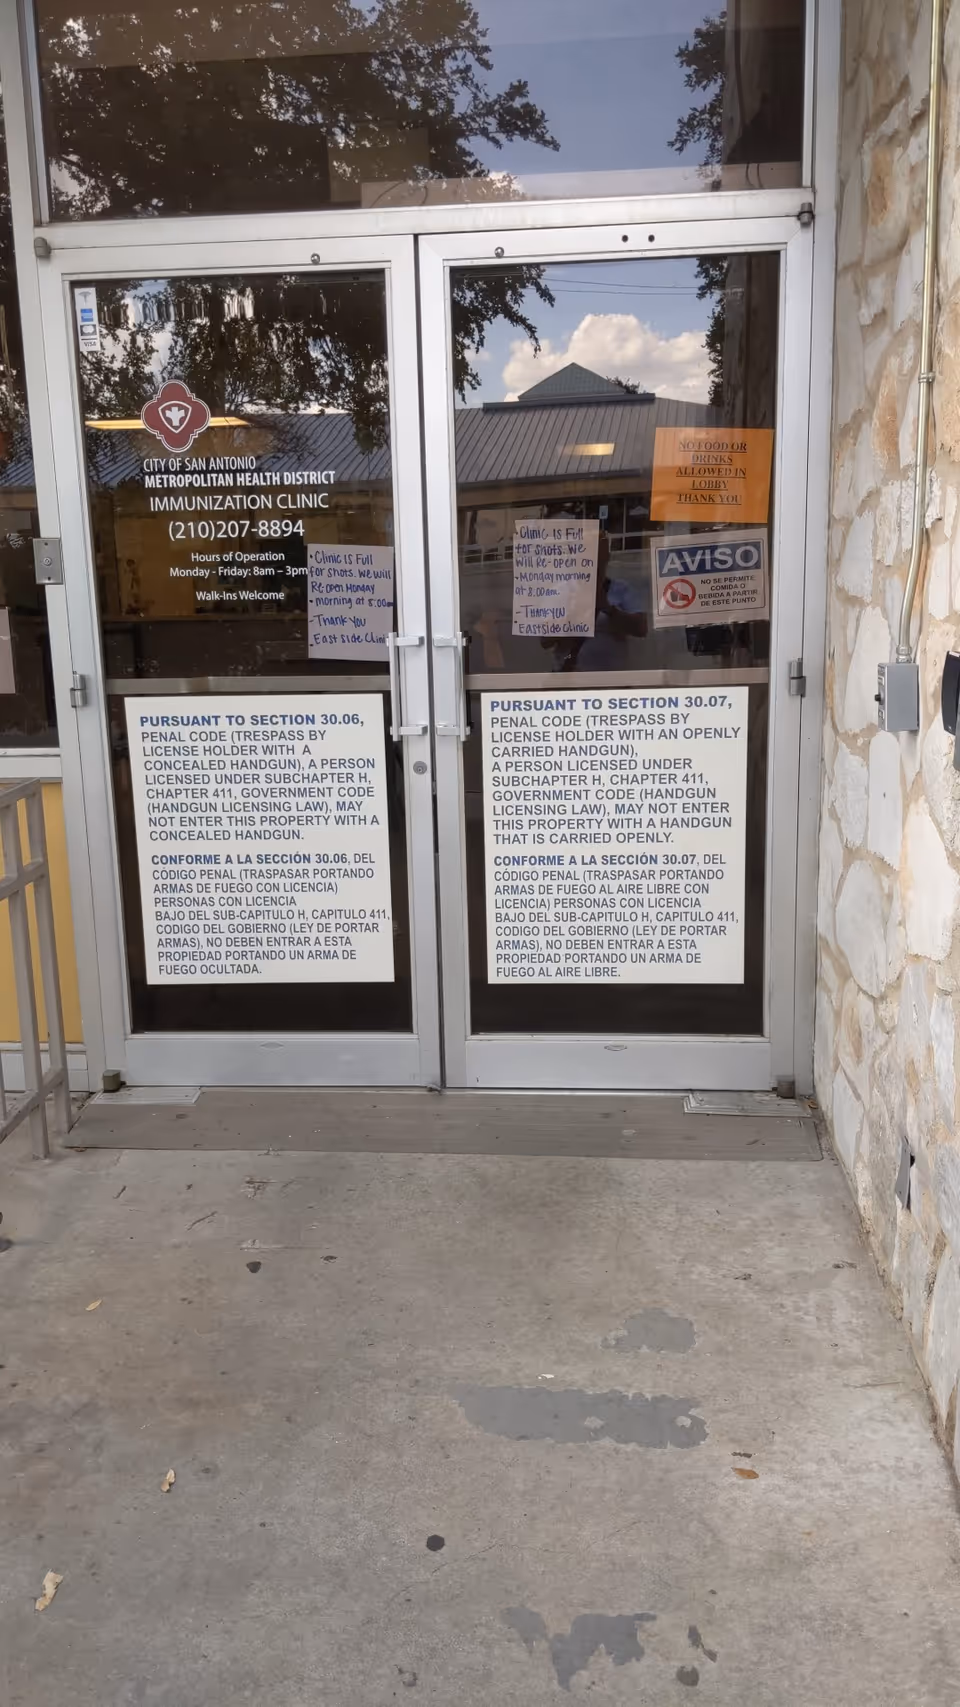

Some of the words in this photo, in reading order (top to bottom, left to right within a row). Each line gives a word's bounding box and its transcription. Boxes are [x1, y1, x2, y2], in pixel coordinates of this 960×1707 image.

[679, 441, 694, 450] NO
[698, 442, 728, 451] FOOD
[731, 442, 747, 451] OR
[143, 459, 166, 472] CITY
[169, 458, 182, 471] OF
[185, 457, 206, 471] SAN
[209, 456, 256, 470] ANTONIO
[692, 454, 732, 463] DRINKS
[676, 467, 731, 476] ALLOWED
[735, 468, 746, 476] IN
[145, 473, 233, 488] METROPOLITAN
[237, 472, 280, 486] HEALTH
[284, 471, 335, 485] DISTRICT
[691, 480, 728, 489] LOBBY
[150, 494, 272, 511] IMMUNIZATION
[277, 493, 329, 509] CLINIC
[677, 494, 715, 503] THANK
[720, 495, 742, 503] YOU
[169, 520, 305, 541] (210)207-8894
[516, 544, 532, 554] for
[192, 553, 220, 562] Hours
[223, 552, 233, 561] of
[235, 552, 285, 562] Operation
[581, 559, 593, 567] on
[662, 546, 758, 574] AVISO
[170, 568, 209, 578] Monday
[218, 566, 251, 577] Friday:
[254, 566, 274, 575] 8am
[286, 566, 308, 577] 3pm
[310, 566, 325, 577] for
[196, 591, 237, 600] Walk-Ins
[240, 591, 284, 600] Welcome
[490, 700, 576, 712] PURSUANT
[582, 699, 602, 710] TO
[608, 697, 679, 709] SECTION
[684, 696, 732, 710] 30.07,
[140, 715, 221, 726] PURSUANT
[226, 715, 245, 726] TO
[250, 714, 315, 725] SECTION
[321, 713, 364, 726] 30.06,
[491, 717, 537, 728] PENAL
[542, 716, 582, 727] CODE
[586, 714, 665, 729] (TRESPASS
[670, 713, 690, 724] BY
[141, 732, 186, 742] PENAL
[189, 731, 226, 742] CODE
[231, 730, 304, 744] (TRESPASS
[309, 730, 326, 740] BY
[492, 731, 550, 742] LICENSE
[555, 730, 614, 741] HOLDER
[618, 729, 654, 740] WITH
[658, 728, 678, 740] AN
[683, 727, 741, 739] OPENLY
[143, 746, 199, 756] LICENSE
[203, 745, 258, 756] HOLDER
[261, 745, 295, 755] WITH
[302, 745, 311, 755] A
[492, 746, 554, 757] CARRIED
[558, 744, 638, 758] HANDGUN),
[144, 759, 226, 770] CONCEALED
[230, 759, 305, 772] HANDGUN),
[308, 758, 317, 769] A
[321, 758, 375, 769] PERSON
[145, 774, 210, 785] LICENSED
[215, 774, 260, 784] UNDER
[265, 773, 354, 784] SUBCHAPTER
[358, 773, 371, 784] H,
[151, 854, 221, 865] CONFORME
[225, 854, 233, 864] A
[237, 854, 252, 864] LA
[256, 851, 311, 864] SECCIÓN
[315, 853, 350, 866] 30.06,
[354, 853, 375, 863] DEL
[494, 856, 564, 866] CONFORME
[569, 856, 577, 865] A
[581, 855, 597, 865] LA
[601, 852, 658, 865] SECCIÓN
[662, 854, 699, 867] 30.07,
[703, 854, 726, 864] DEL
[152, 867, 196, 880] CÓDIGO
[200, 869, 236, 880] PENAL
[239, 868, 309, 882] (TRASPASAR
[313, 868, 374, 878] PORTANDO
[494, 868, 539, 881] CÓDIGO
[542, 870, 580, 881] PENAL
[583, 869, 656, 883] (TRASPASAR
[659, 869, 724, 880] PORTANDO
[153, 883, 193, 894] ARMAS
[196, 883, 211, 893] DE
[215, 883, 252, 893] FUEGO
[256, 882, 280, 893] CON
[283, 882, 338, 895] LICENCIA)
[495, 885, 534, 895] ARMAS
[538, 884, 553, 895] DE
[557, 884, 596, 895] FUEGO
[599, 883, 613, 894] AL
[616, 883, 643, 894] AIRE
[647, 883, 680, 894] LIBRE
[684, 882, 709, 894] CON
[154, 896, 215, 907] PERSONAS
[218, 896, 242, 907] CON
[246, 896, 296, 906] LICENCIA
[495, 898, 550, 911] LICENCIA)
[554, 898, 616, 908] PERSONAS
[619, 897, 644, 908] CON
[648, 897, 701, 908] LICENCIA
